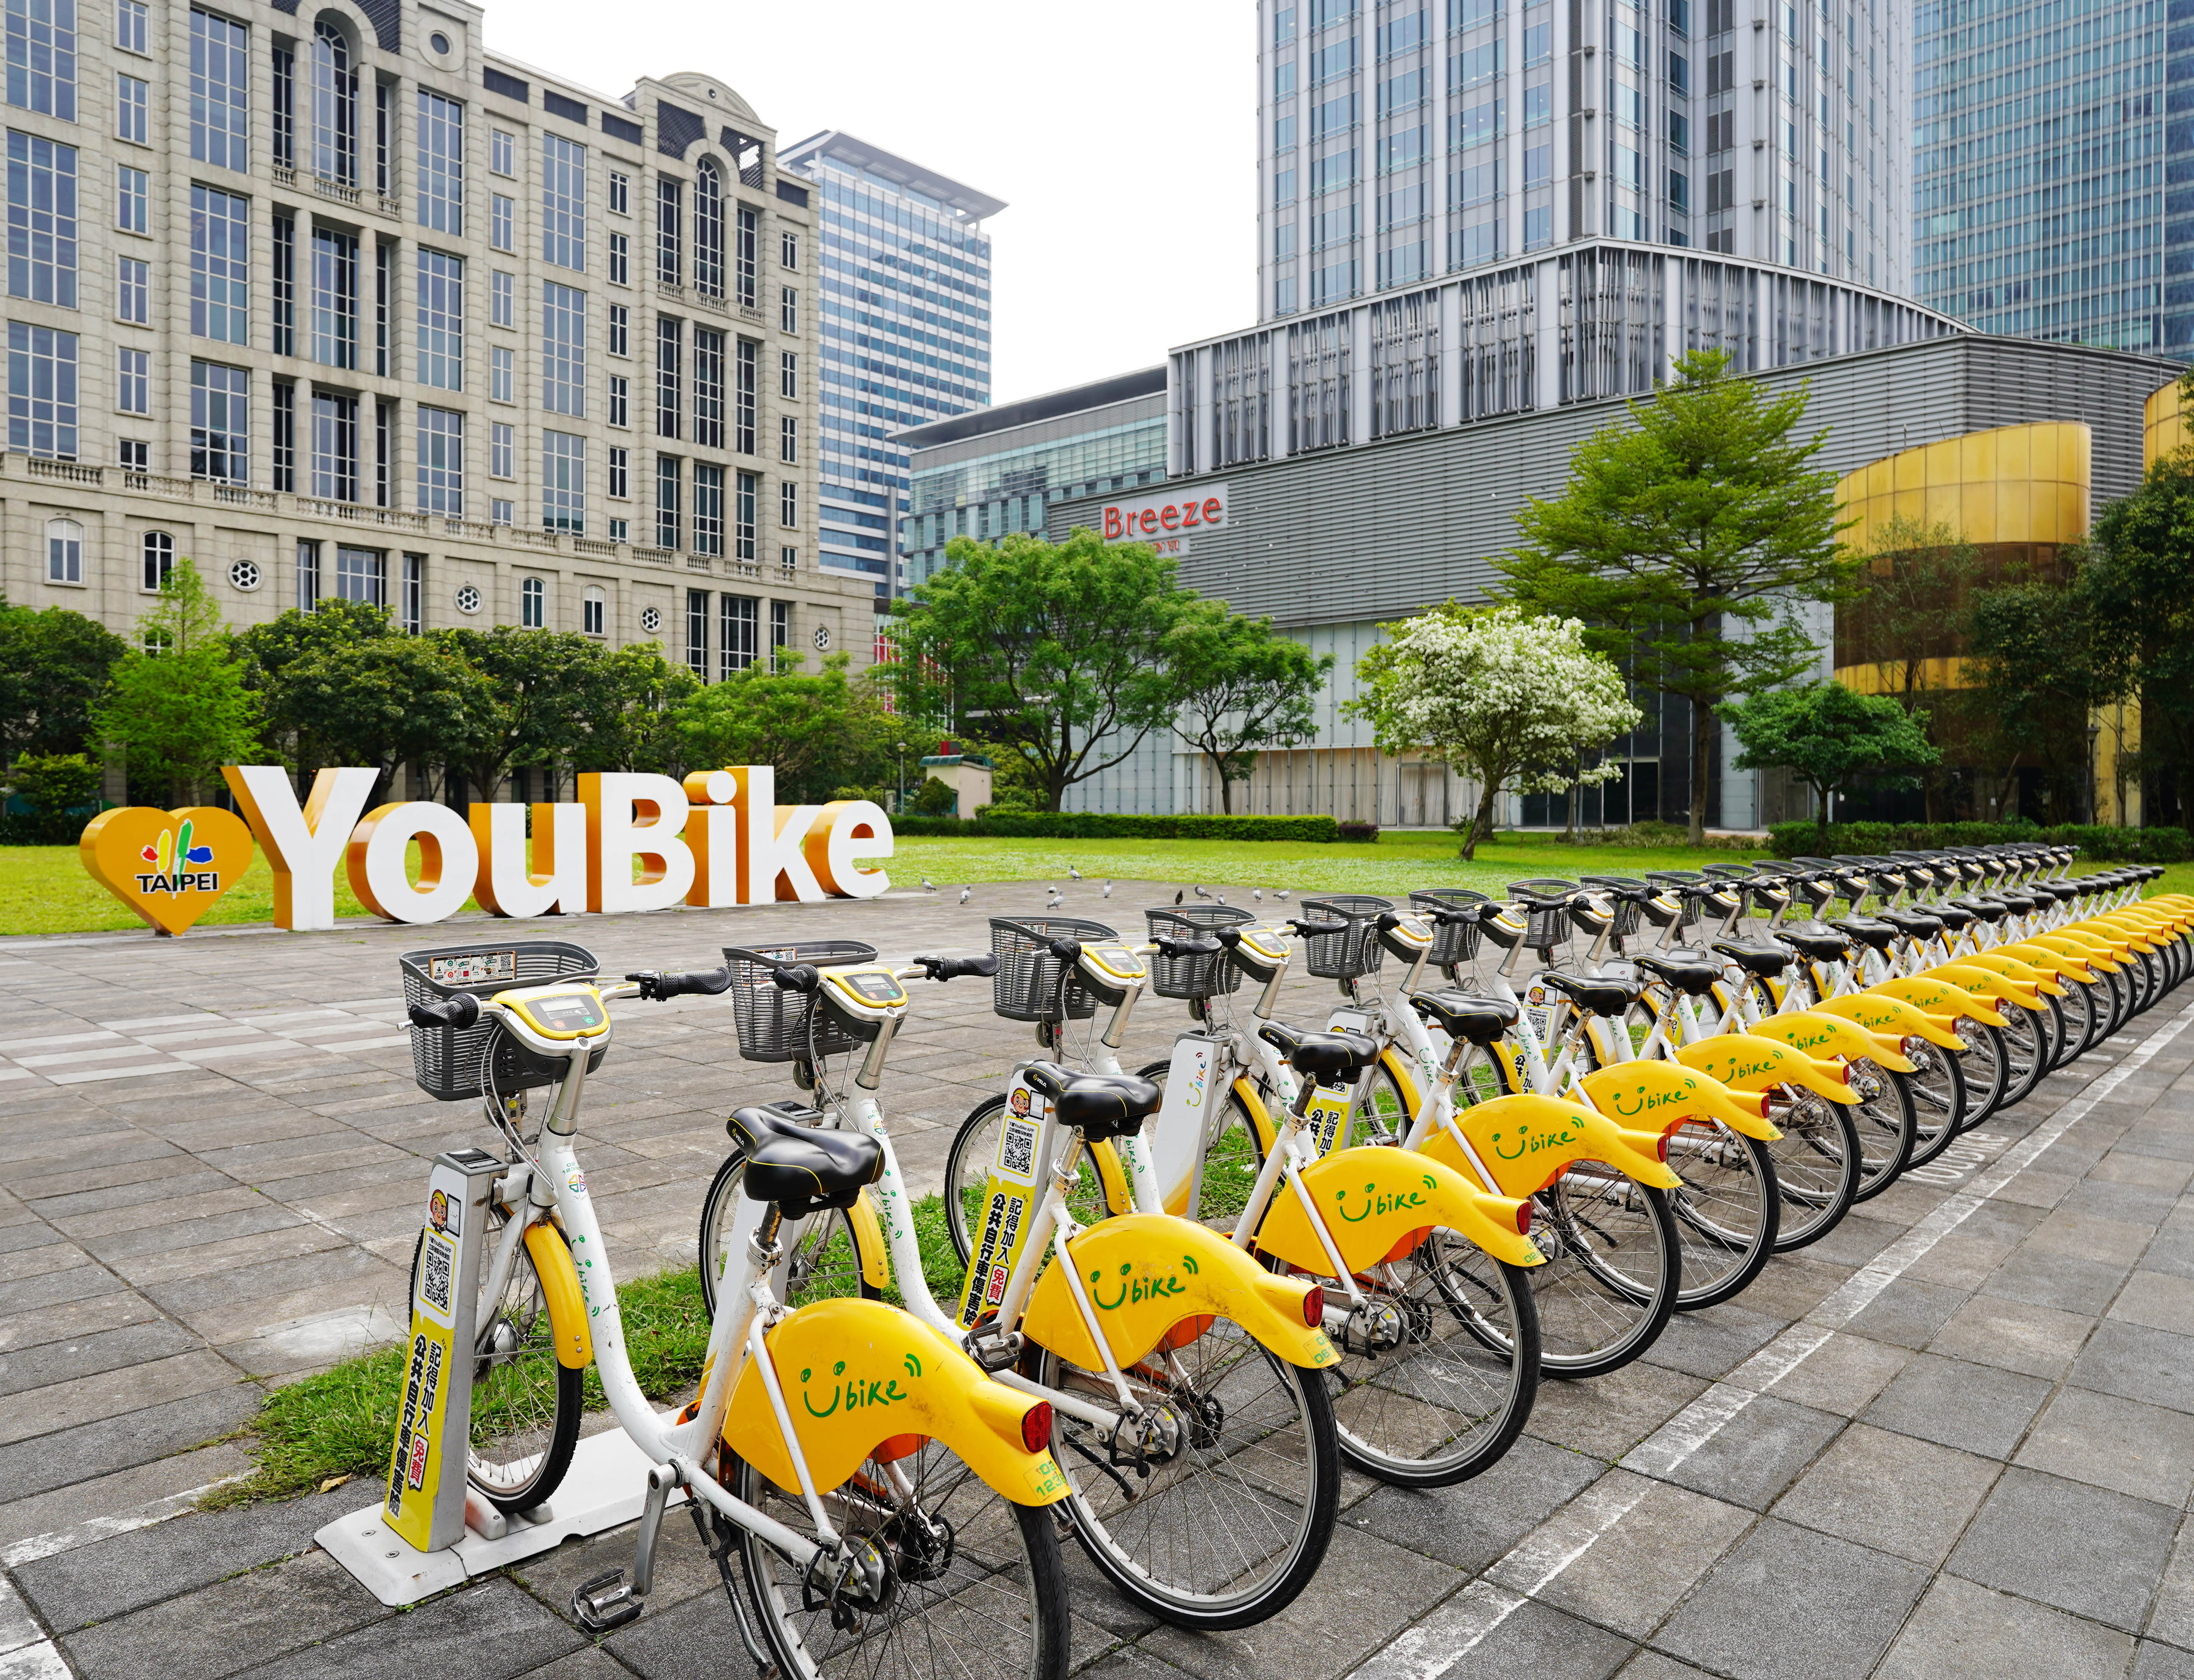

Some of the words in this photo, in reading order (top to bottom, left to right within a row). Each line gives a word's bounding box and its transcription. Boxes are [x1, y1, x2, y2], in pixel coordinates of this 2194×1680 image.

[1104, 498, 1222, 539] Breeze
[221, 765, 894, 931] YouBike
[136, 872, 218, 894] TAIPEI
[1037, 1077, 1047, 1087] VELO
[1192, 1060, 1206, 1107] Ubike
[1617, 1090, 1688, 1116] Ubike
[735, 1133, 744, 1146] VELO
[1496, 1131, 1576, 1160] Ubike
[1340, 1192, 1427, 1222] Ubike
[996, 1197, 1023, 1265] 記得加入
[963, 1193, 1007, 1326] 公共自行車傷害險
[988, 1268, 1005, 1301] 免費
[1093, 1276, 1186, 1310] Ubike
[417, 1341, 443, 1436] 記得加入
[804, 1379, 907, 1418] Ubike
[388, 1334, 427, 1518] 公共自行車傷害險
[410, 1439, 424, 1484] 免費
